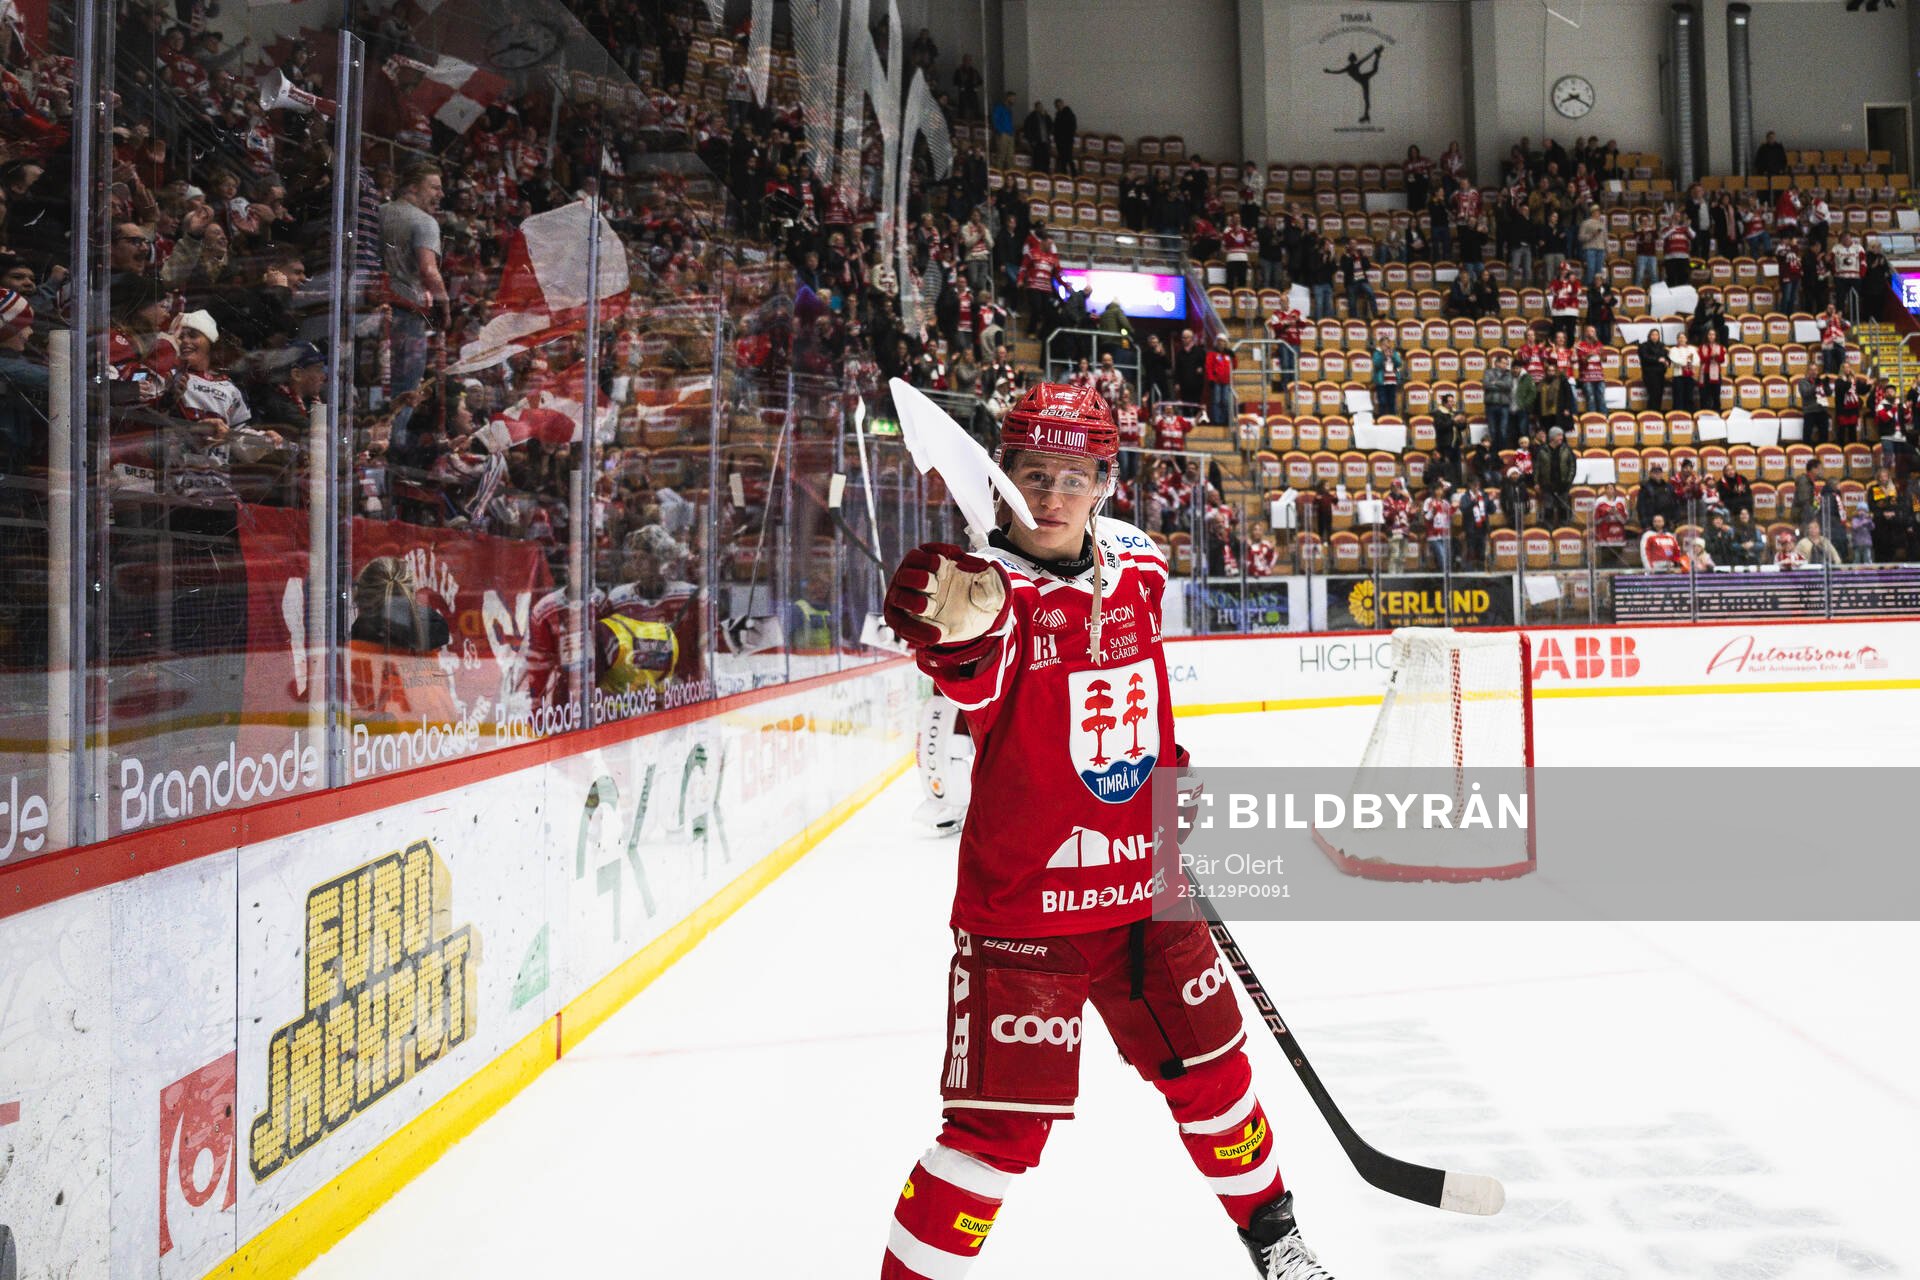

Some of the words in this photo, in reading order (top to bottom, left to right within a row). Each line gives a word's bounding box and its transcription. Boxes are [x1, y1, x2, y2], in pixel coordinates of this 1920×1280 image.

[1046, 428, 1086, 448] LILIUM
[1084, 604, 1134, 630] HGHCON
[1110, 632, 1138, 648] SAXNÄS
[1111, 645, 1138, 660] GÅRDEN
[1532, 636, 1641, 680] ABB
[1706, 634, 1854, 675] Antonsson
[1096, 767, 1129, 796] TIMRÅ
[1130, 768, 1140, 787] IK
[1042, 868, 1169, 912] BILBOLAGET
[308, 841, 434, 1008] EURO
[252, 931, 471, 1172] JACKPOT
[991, 1014, 1082, 1052] coop
